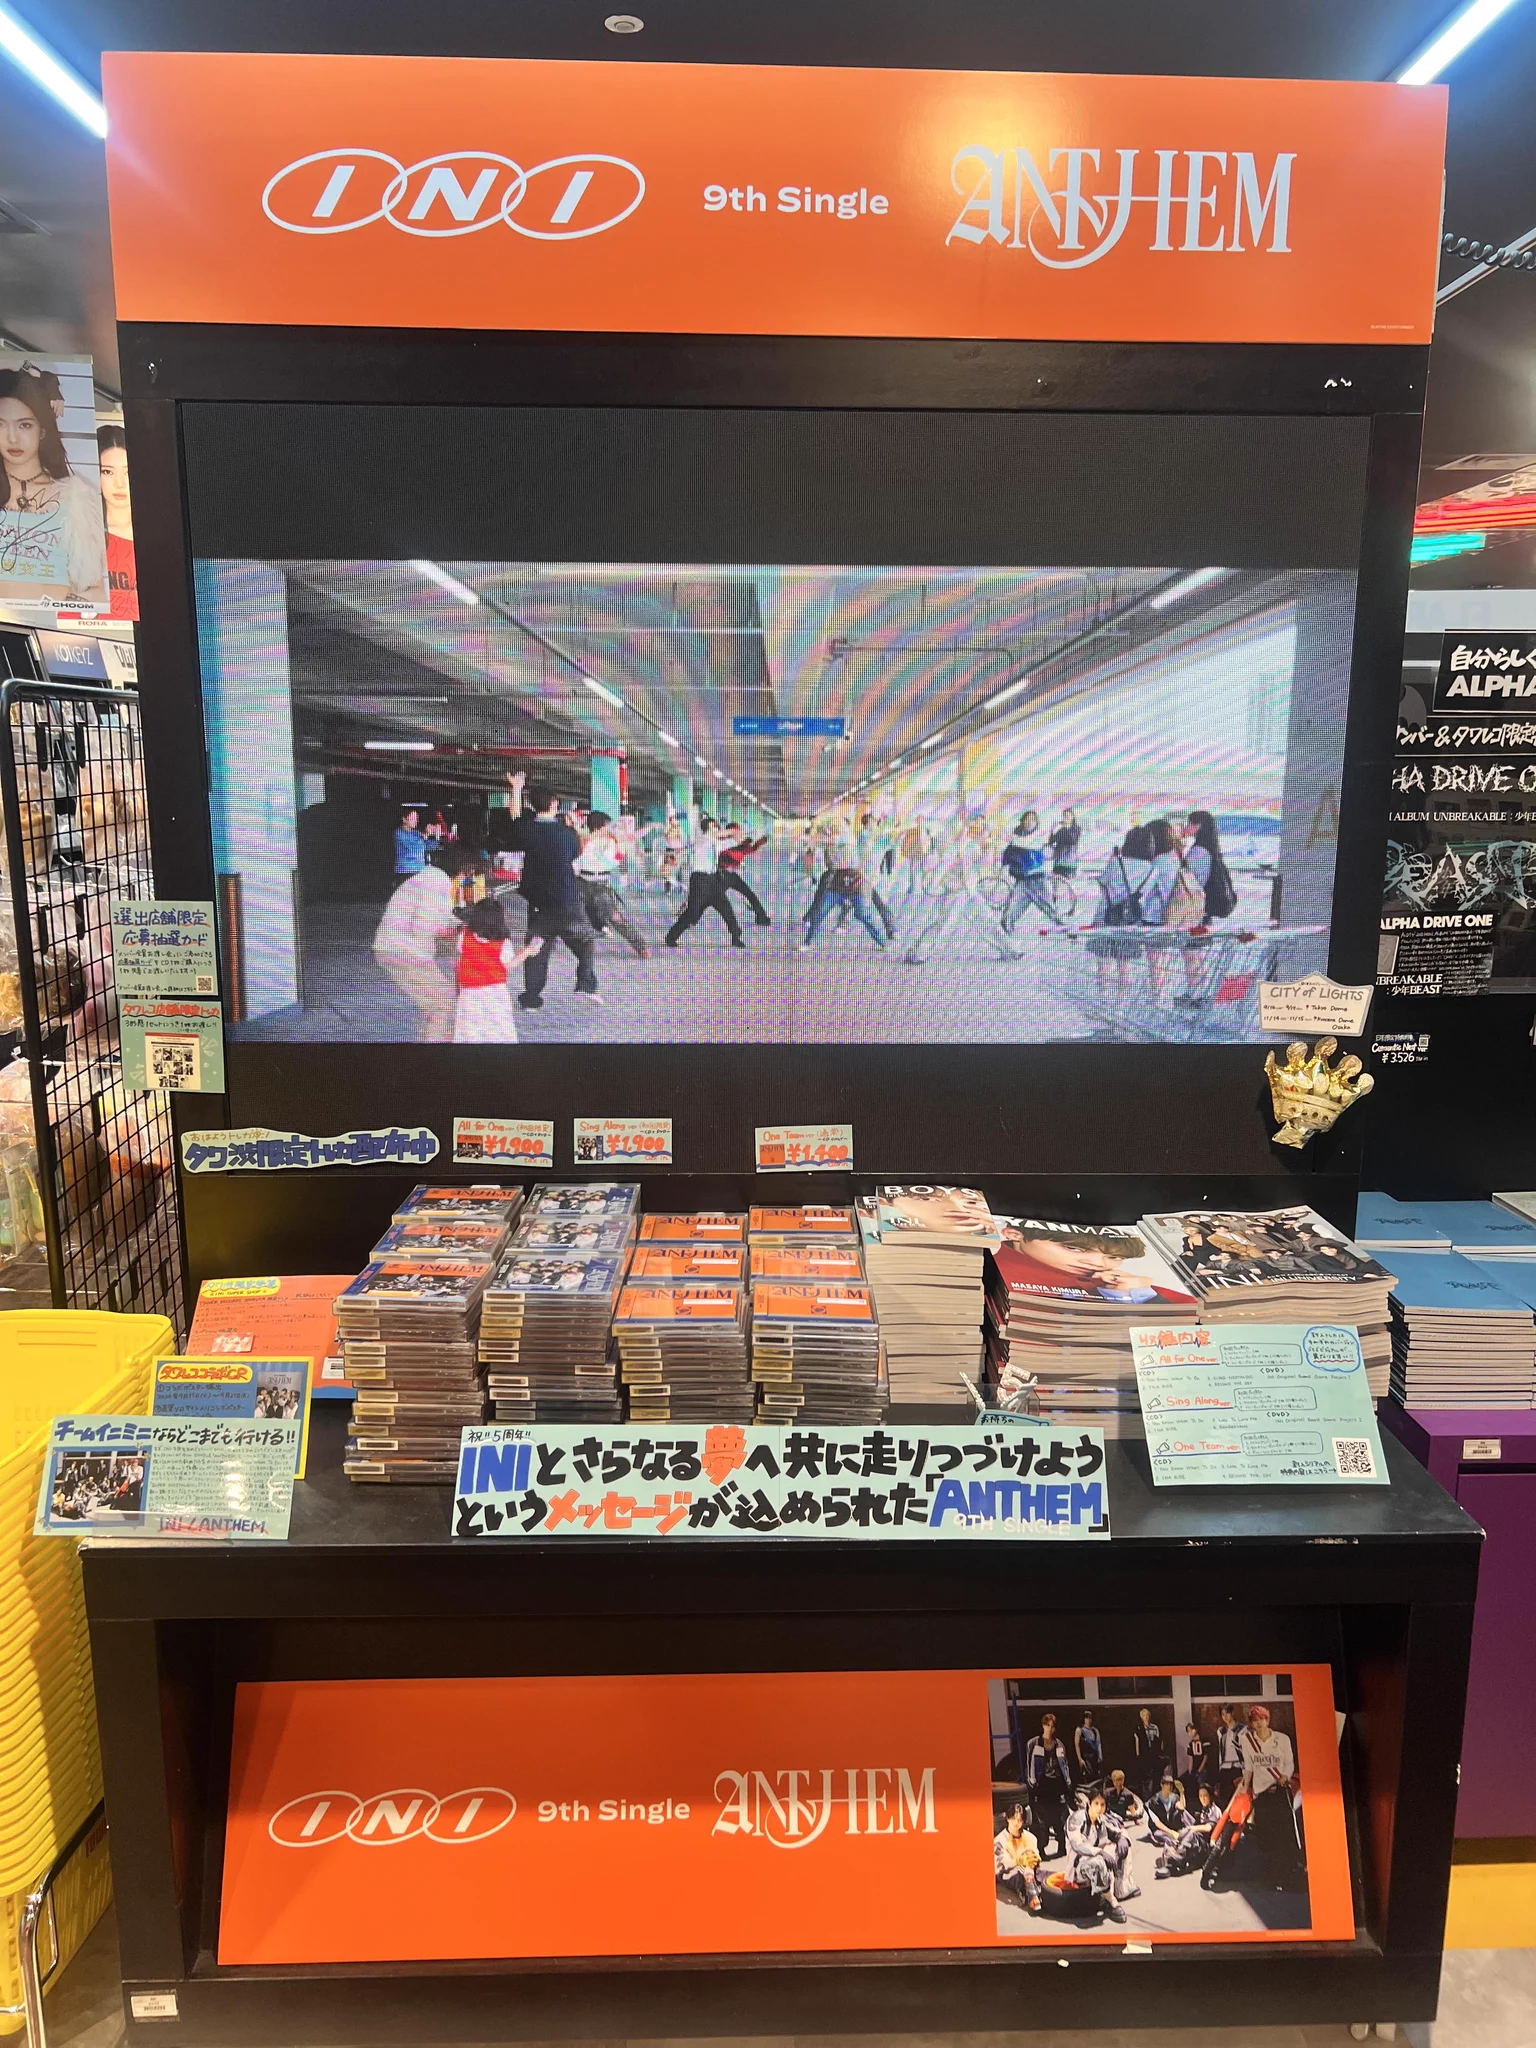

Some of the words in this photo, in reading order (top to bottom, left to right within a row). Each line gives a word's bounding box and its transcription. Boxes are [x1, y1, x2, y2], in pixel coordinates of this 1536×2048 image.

[703, 184, 767, 213] 9th
[777, 185, 889, 219] Single
[944, 143, 1298, 269] ANTHEM
[52, 601, 94, 609] CHOOM
[1433, 811, 1507, 822] UNBREAKABLE
[1423, 915, 1462, 929] DRIVE
[1464, 914, 1494, 927] ONE
[122, 927, 208, 946] 応募抽選カード
[1270, 986, 1301, 998] CITY
[1302, 986, 1316, 998] of
[1319, 988, 1364, 1000] LIGHTS
[457, 1121, 471, 1132] All
[475, 1121, 486, 1131] for
[487, 1121, 505, 1132] One
[579, 1121, 600, 1132] Sing
[603, 1120, 626, 1132] Along
[763, 1131, 781, 1142] One
[783, 1130, 805, 1140] Team
[884, 1185, 979, 1200] BOYS
[1010, 1282, 1050, 1292] MASAYA
[1051, 1286, 1089, 1295] KIMURA
[1159, 1355, 1171, 1364] All
[1174, 1355, 1185, 1363] for
[1187, 1353, 1206, 1363] One
[1166, 1396, 1190, 1407] Sing
[1194, 1396, 1219, 1406] Along
[1173, 1440, 1195, 1452] One
[1199, 1440, 1224, 1450] Team
[200, 1516, 267, 1533] ANTHEM
[1003, 1515, 1072, 1536] SINGLE
[536, 1798, 590, 1823] 9th
[597, 1797, 691, 1825] Single
[710, 1766, 939, 1849] ANTHEM
